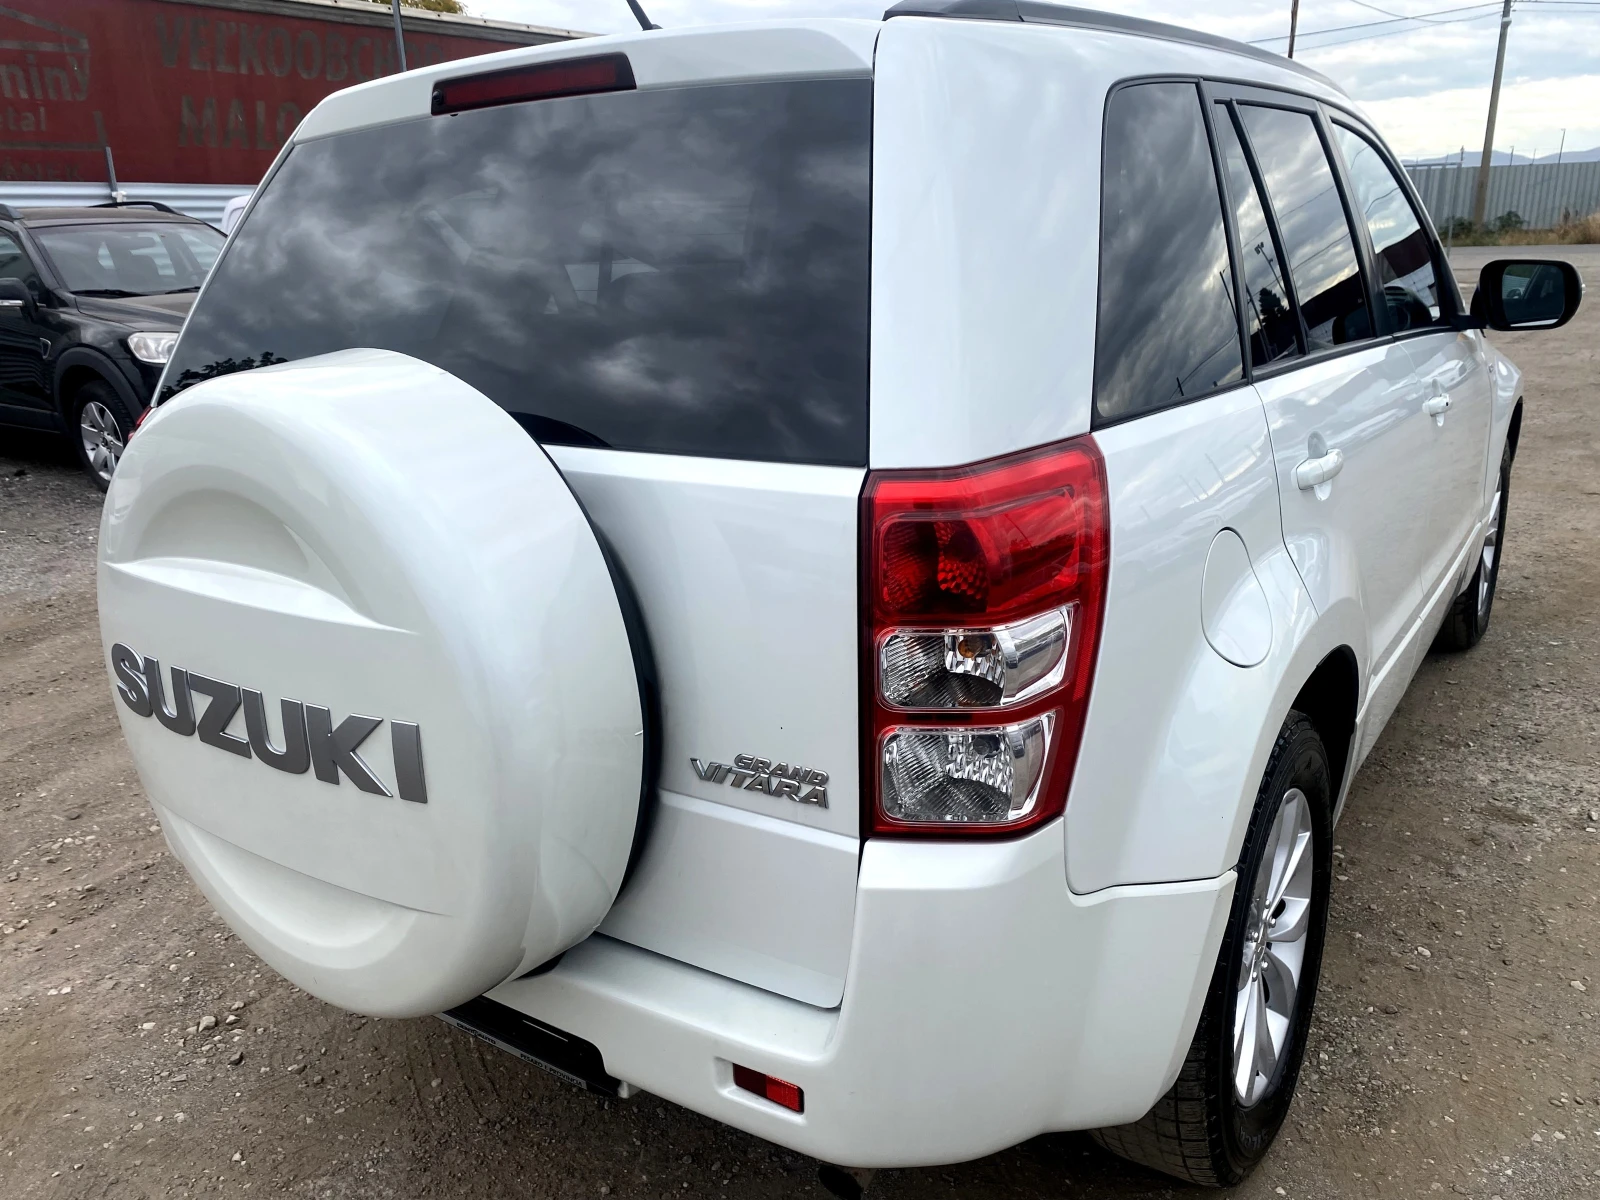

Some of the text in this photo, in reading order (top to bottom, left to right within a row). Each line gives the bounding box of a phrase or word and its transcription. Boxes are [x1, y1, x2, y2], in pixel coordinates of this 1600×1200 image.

[111, 642, 428, 804] SUZUKI
[690, 757, 829, 809] VITARA
[734, 753, 829, 785] GRAND
